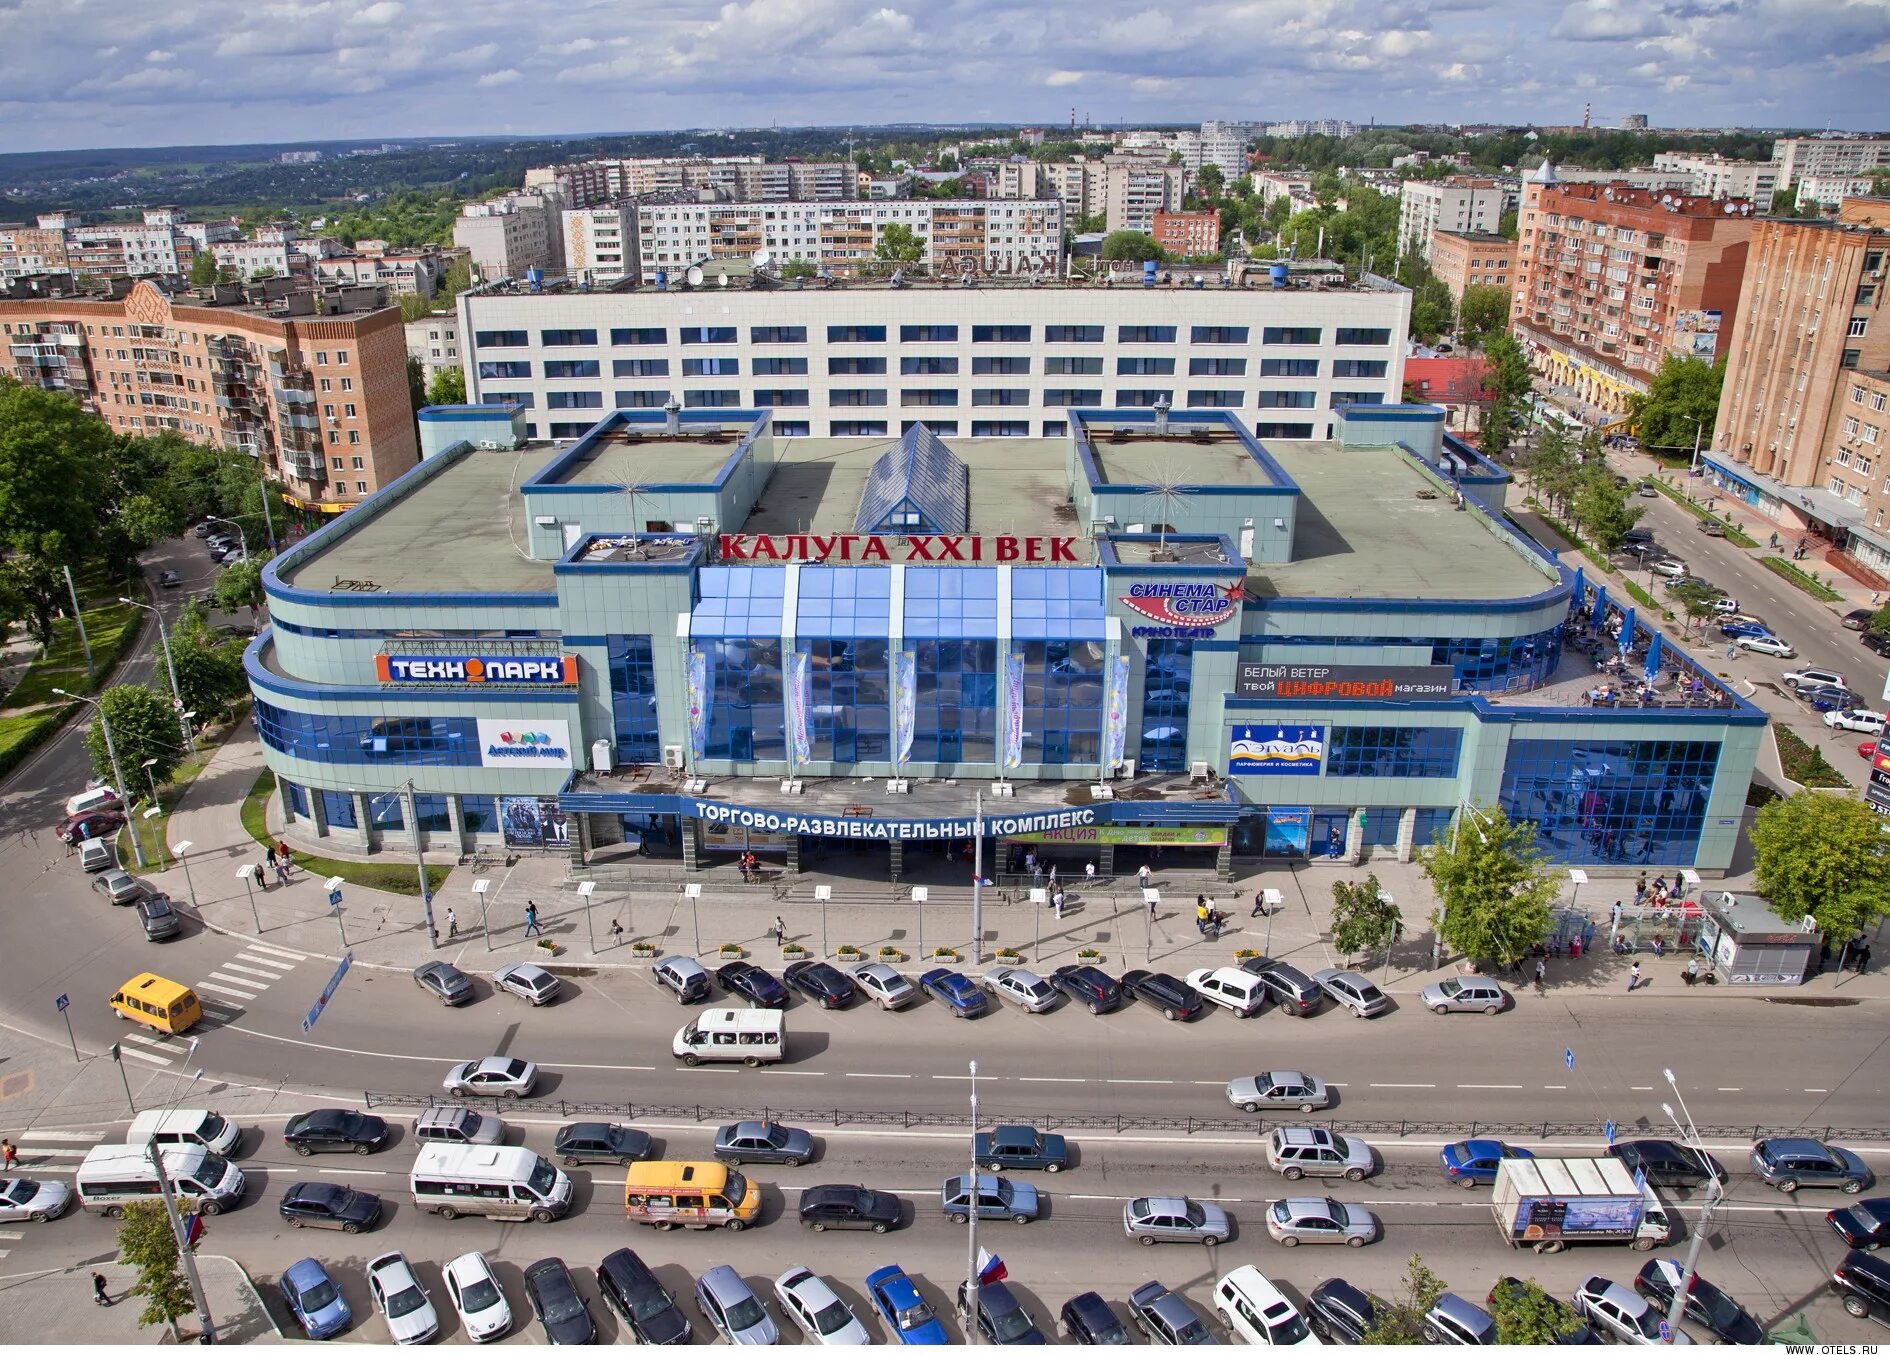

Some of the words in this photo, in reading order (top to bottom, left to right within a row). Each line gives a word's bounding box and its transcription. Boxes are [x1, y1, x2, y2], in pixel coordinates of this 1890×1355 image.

[720, 533, 891, 561] КАЛУГА
[906, 536, 983, 561] XXI
[995, 536, 1079, 562] ВЕК
[1129, 582, 1216, 598] СИНЕМА
[1175, 599, 1230, 612] СТАР
[1244, 665, 1287, 678] БЕЛЫЙ
[1291, 668, 1330, 678] ВЕТЕР
[1243, 681, 1275, 691] твой
[1276, 679, 1393, 697] ЦИФРОВОЙ
[1395, 684, 1447, 693] магазин
[540, 747, 566, 760] мир
[992, 809, 1094, 835] КОМПЛЕКС
[1043, 828, 1097, 842] АКЦИЯ
